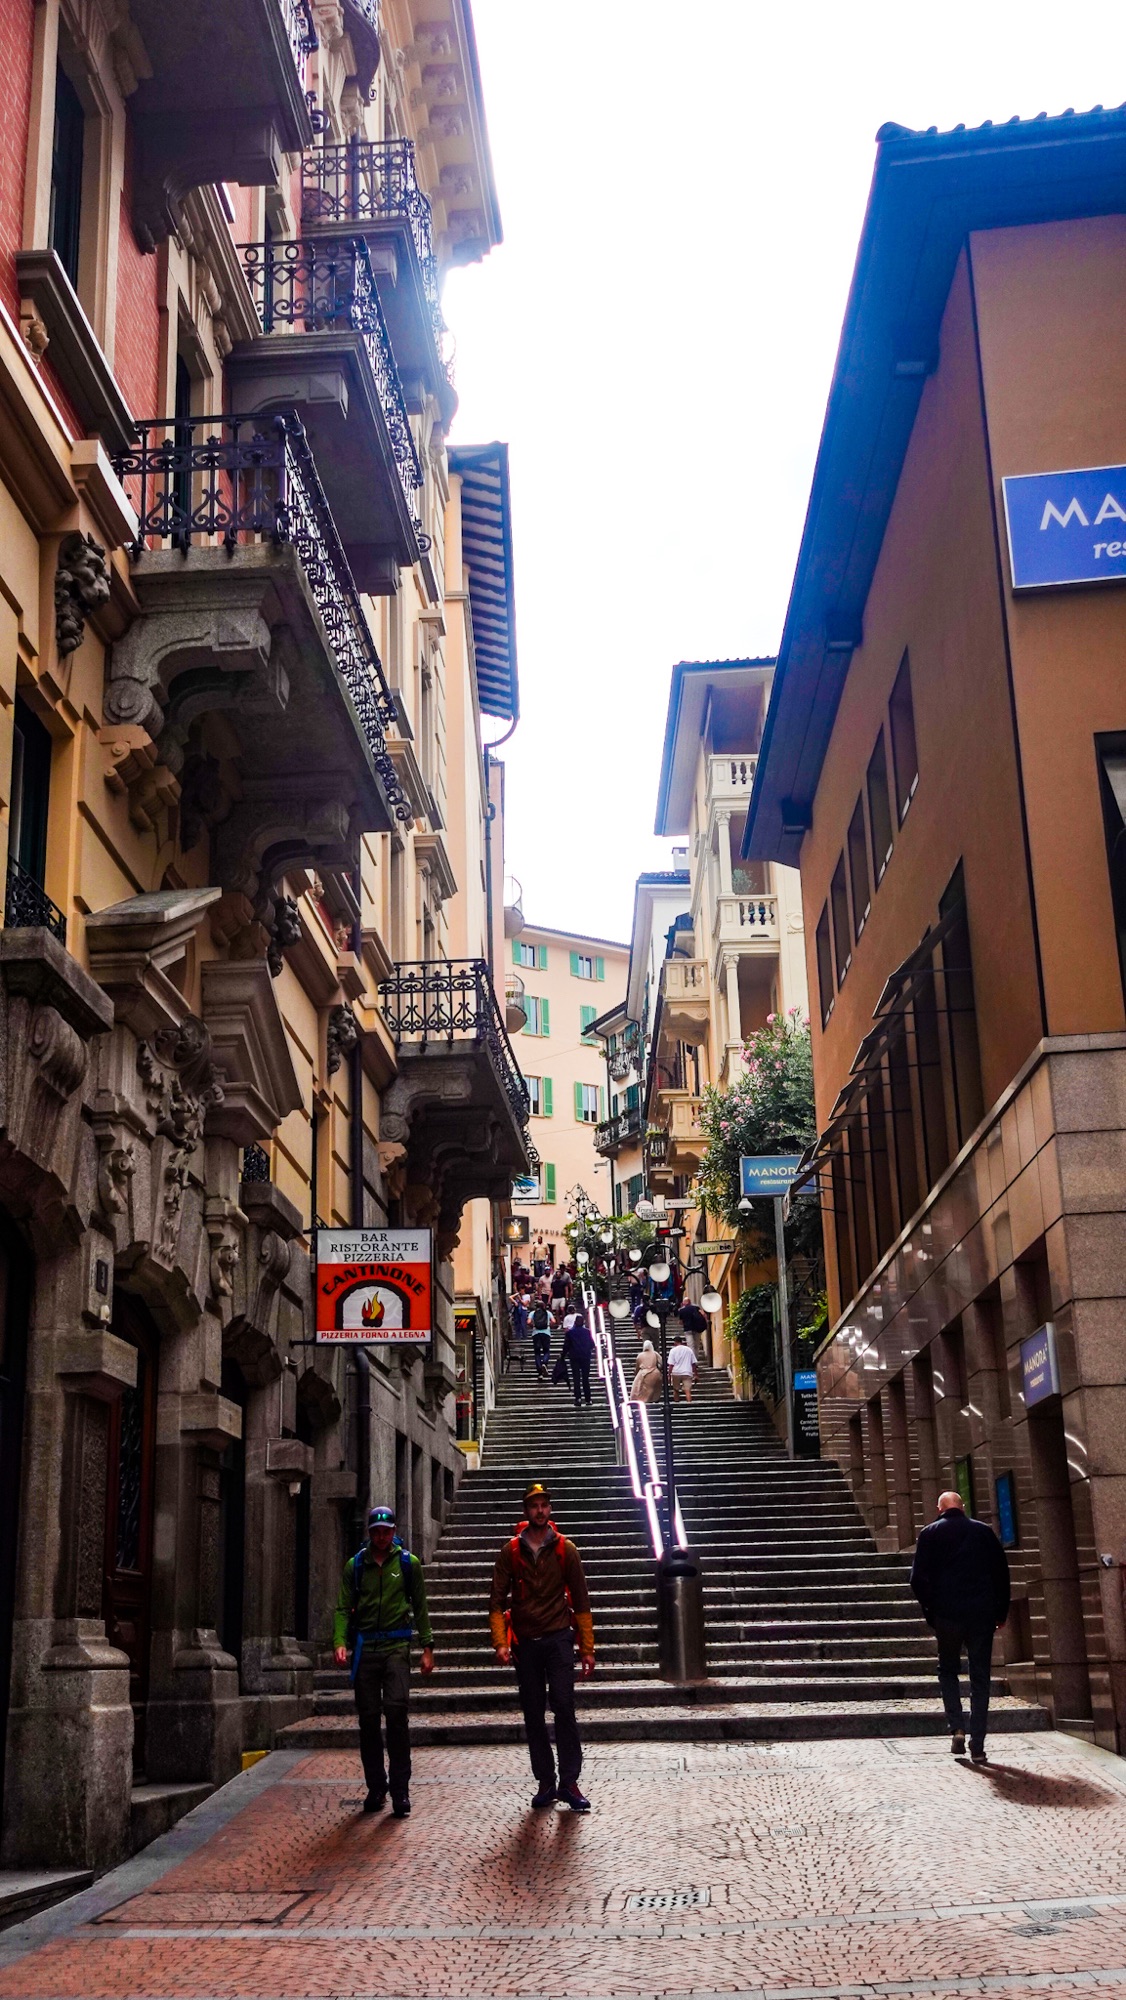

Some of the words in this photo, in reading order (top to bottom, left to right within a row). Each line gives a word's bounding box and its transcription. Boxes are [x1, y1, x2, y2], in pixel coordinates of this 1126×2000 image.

[361, 1233, 388, 1242] BAR
[330, 1242, 419, 1253] RISTORANTE
[344, 1253, 405, 1262] PIZZERIA
[322, 1265, 426, 1296] CANTINONE
